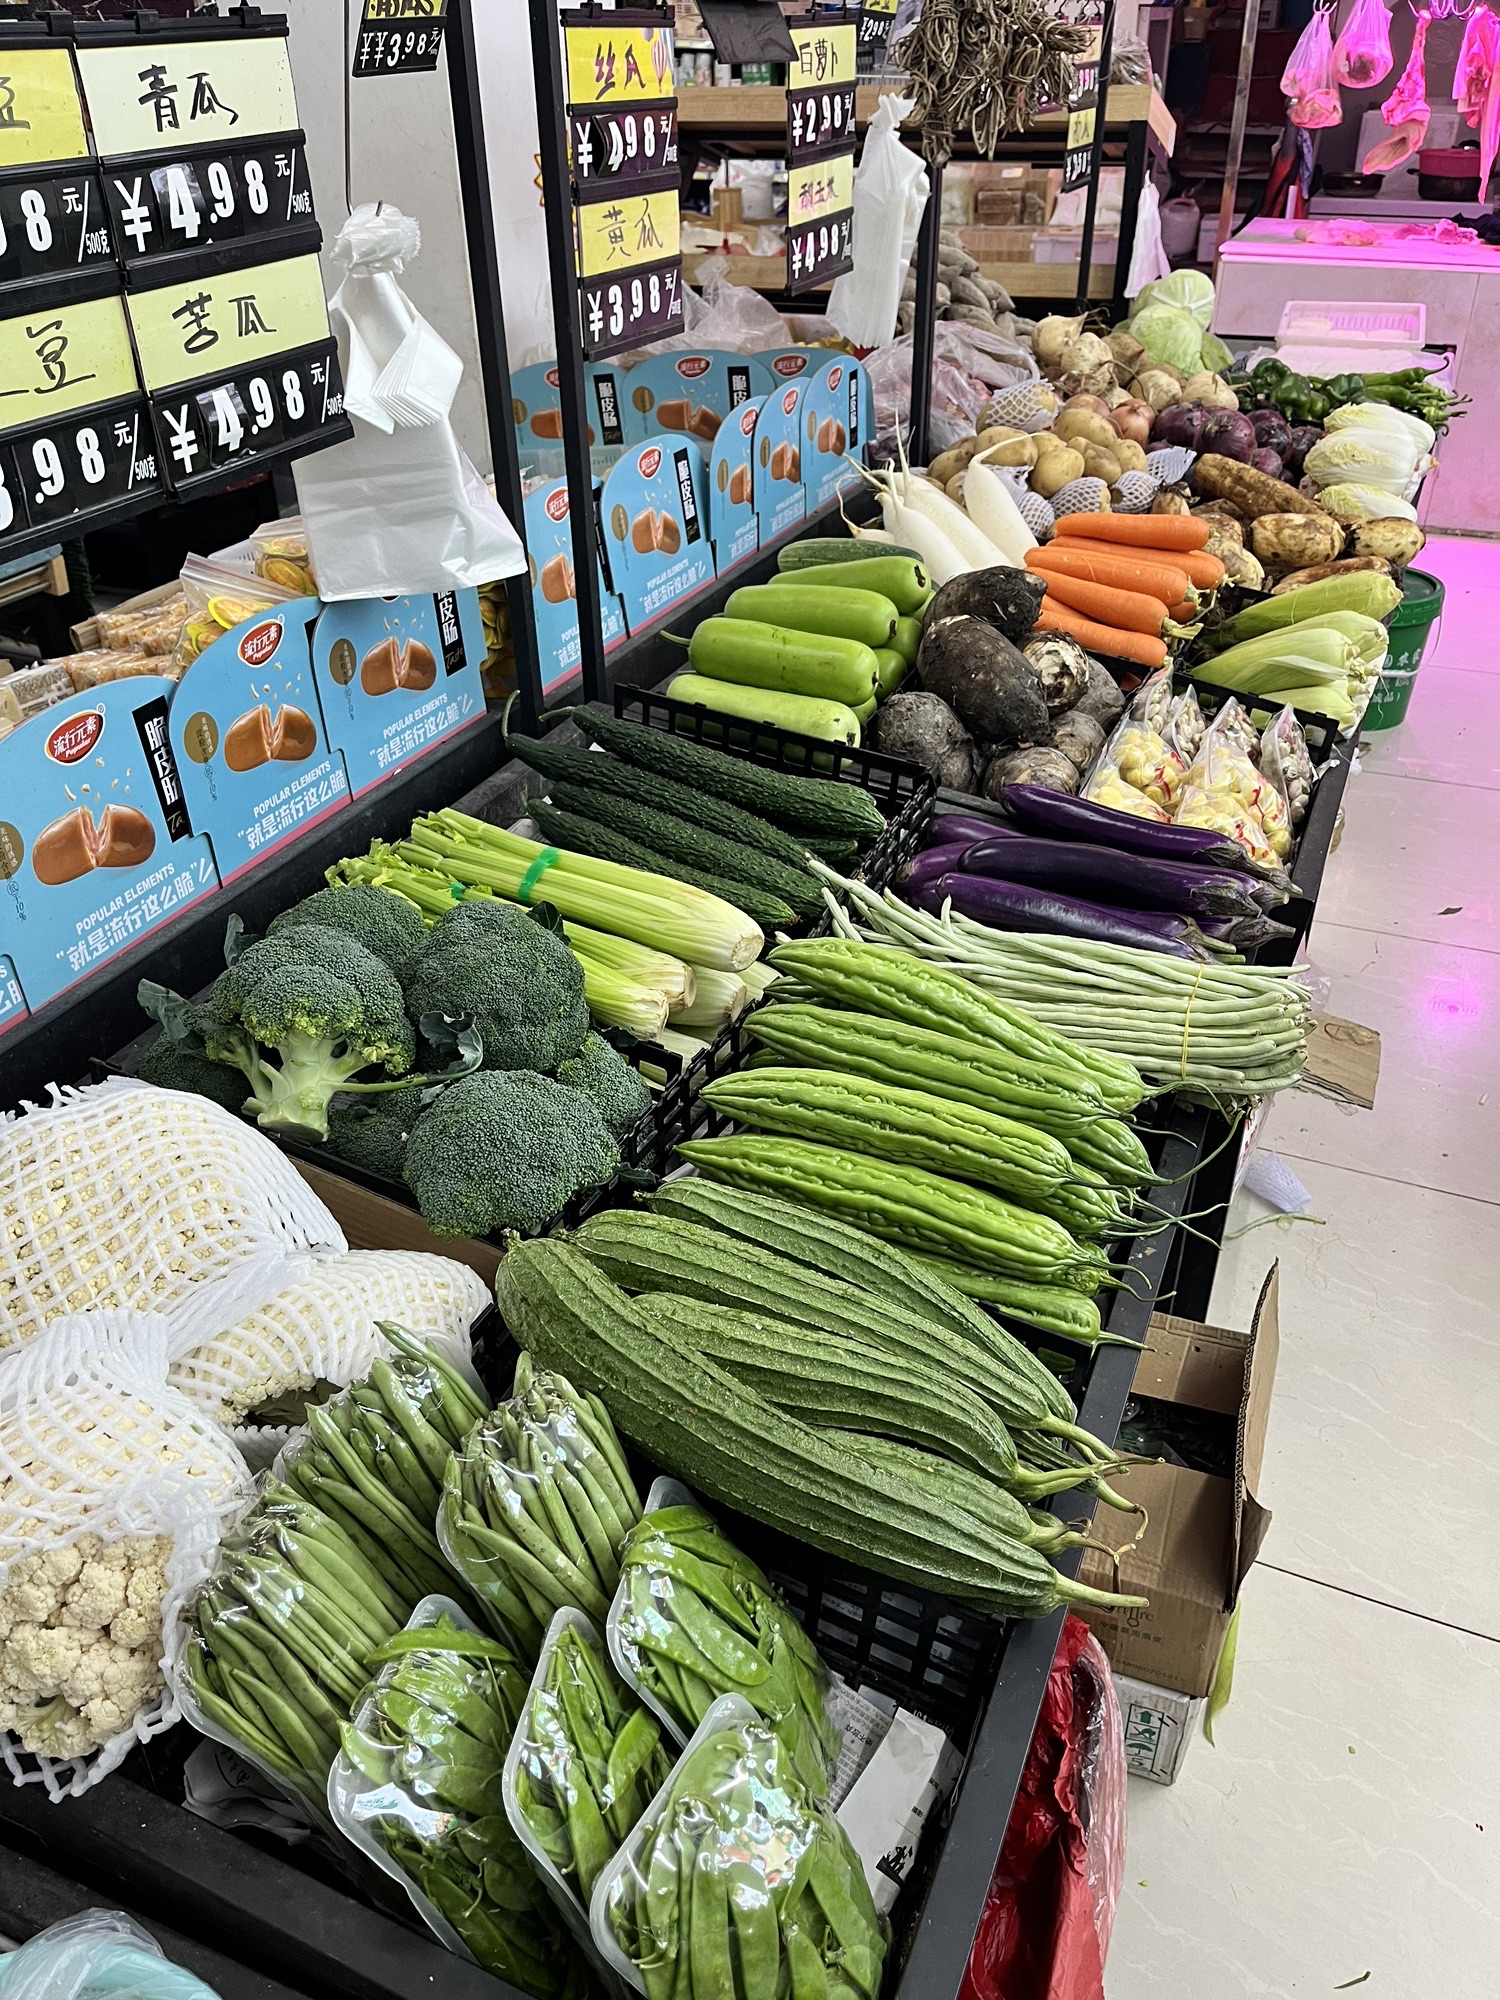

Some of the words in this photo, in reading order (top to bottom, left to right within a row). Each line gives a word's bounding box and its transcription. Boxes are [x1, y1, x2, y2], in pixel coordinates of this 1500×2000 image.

[138, 64, 240, 133] 青瓜
[792, 94, 842, 147] ¥2.98
[112, 159, 270, 254] ¥4.98
[597, 197, 664, 262] 黄瓜
[791, 223, 839, 280] ¥4.98
[172, 292, 277, 355] 苦瓜
[586, 274, 662, 343] ¥3.98
[162, 369, 306, 475] ¥4.98
[677, 459, 696, 521] 脆皮肠
[244, 624, 278, 660] 流行元素
[52, 715, 98, 758] 流行元素
[382, 713, 415, 740] POPULAR
[414, 692, 448, 721] ELEMENTS
[253, 786, 291, 819] POPULAR
[290, 760, 332, 794] ELEMENTS
[75, 895, 125, 935] POPULAR
[123, 862, 176, 904] ELEMENTS
